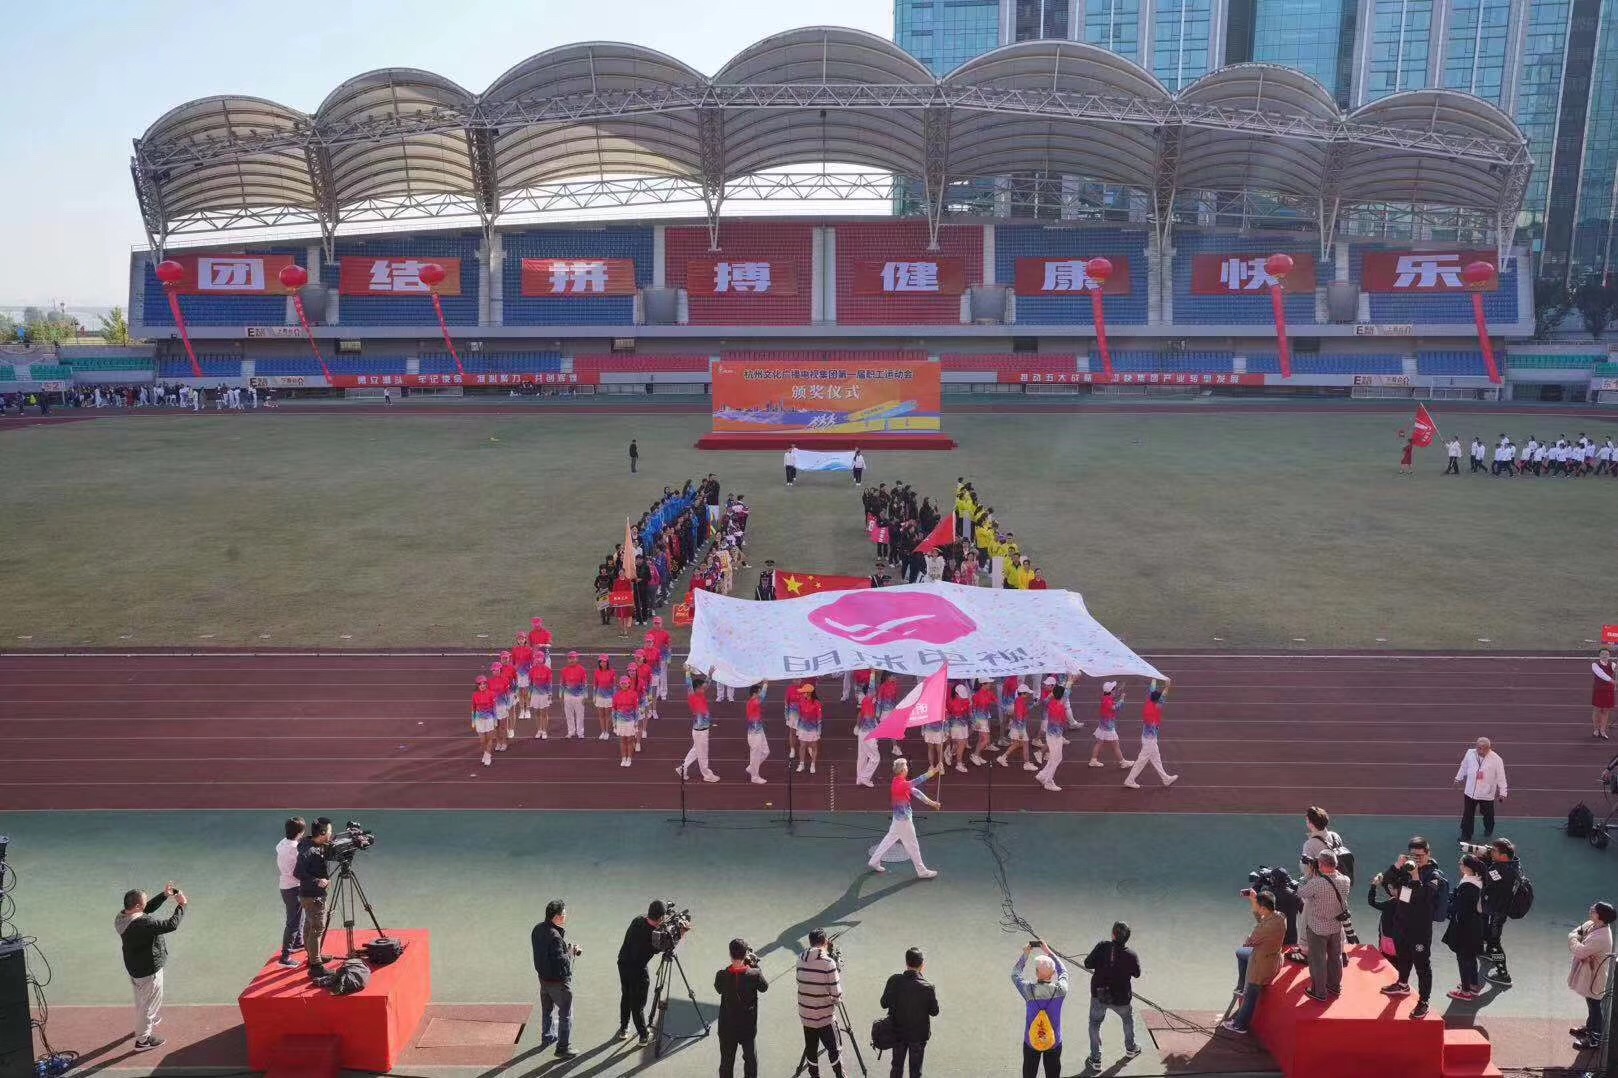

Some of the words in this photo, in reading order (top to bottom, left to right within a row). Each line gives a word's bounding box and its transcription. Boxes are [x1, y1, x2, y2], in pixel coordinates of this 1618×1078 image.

[198, 257, 265, 290] 团
[368, 259, 433, 291] 结
[549, 262, 609, 293] 拼
[713, 262, 772, 292] 搏
[880, 261, 940, 292] 健
[1040, 260, 1103, 291] 康
[1220, 257, 1282, 290] 快
[1393, 254, 1463, 288] 乐
[792, 384, 861, 400] 颁奖仪式
